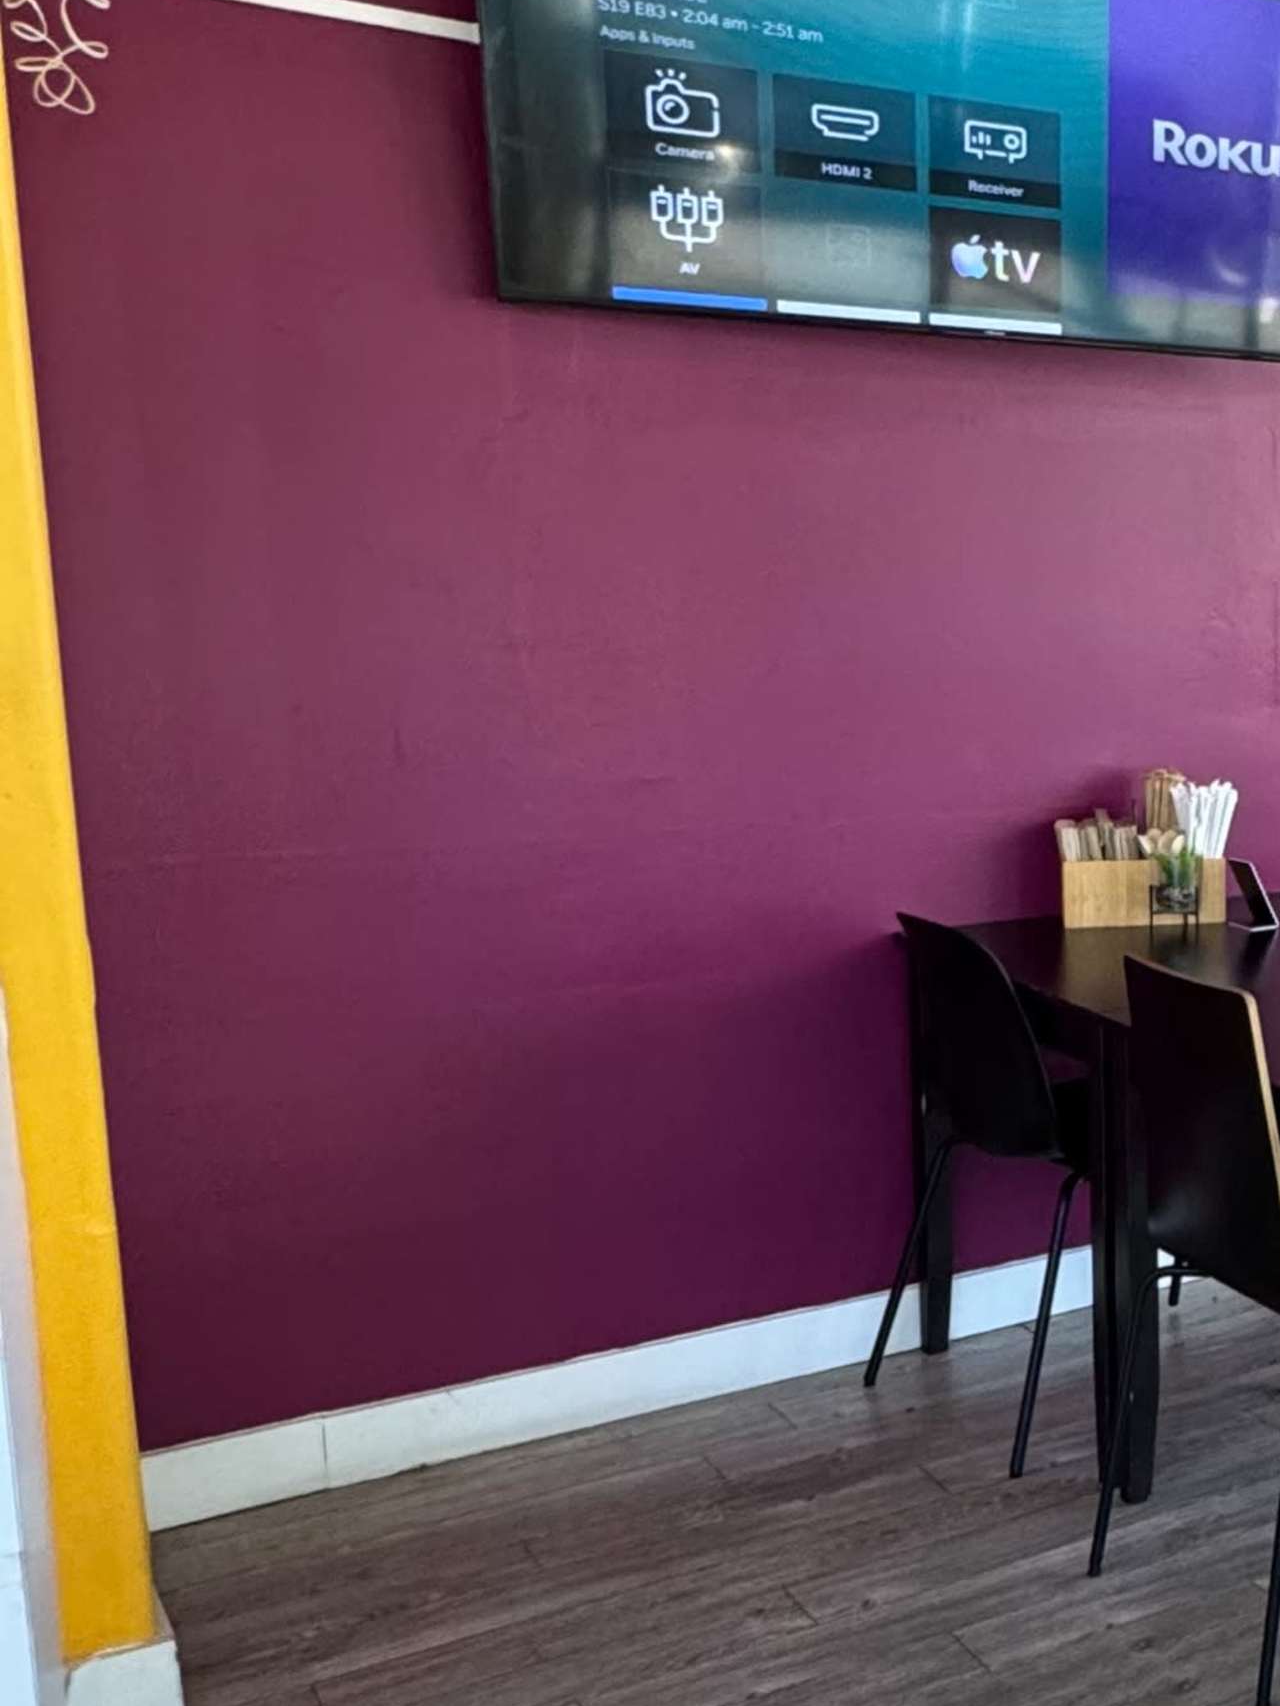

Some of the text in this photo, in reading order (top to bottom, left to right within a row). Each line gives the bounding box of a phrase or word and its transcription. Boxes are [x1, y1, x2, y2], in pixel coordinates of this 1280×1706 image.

[635, 1, 666, 19] E83
[682, 9, 719, 27] 2:04
[722, 17, 748, 31] am
[762, 22, 794, 39] 2:51
[798, 29, 823, 43] am
[600, 25, 695, 50] Apps & Inputs
[655, 143, 715, 161] Camera
[1153, 118, 1280, 178] Roku
[821, 162, 872, 180] HDMI 2
[968, 179, 1024, 197] Receiver
[679, 261, 700, 275] AV
[990, 240, 1041, 284] tv
